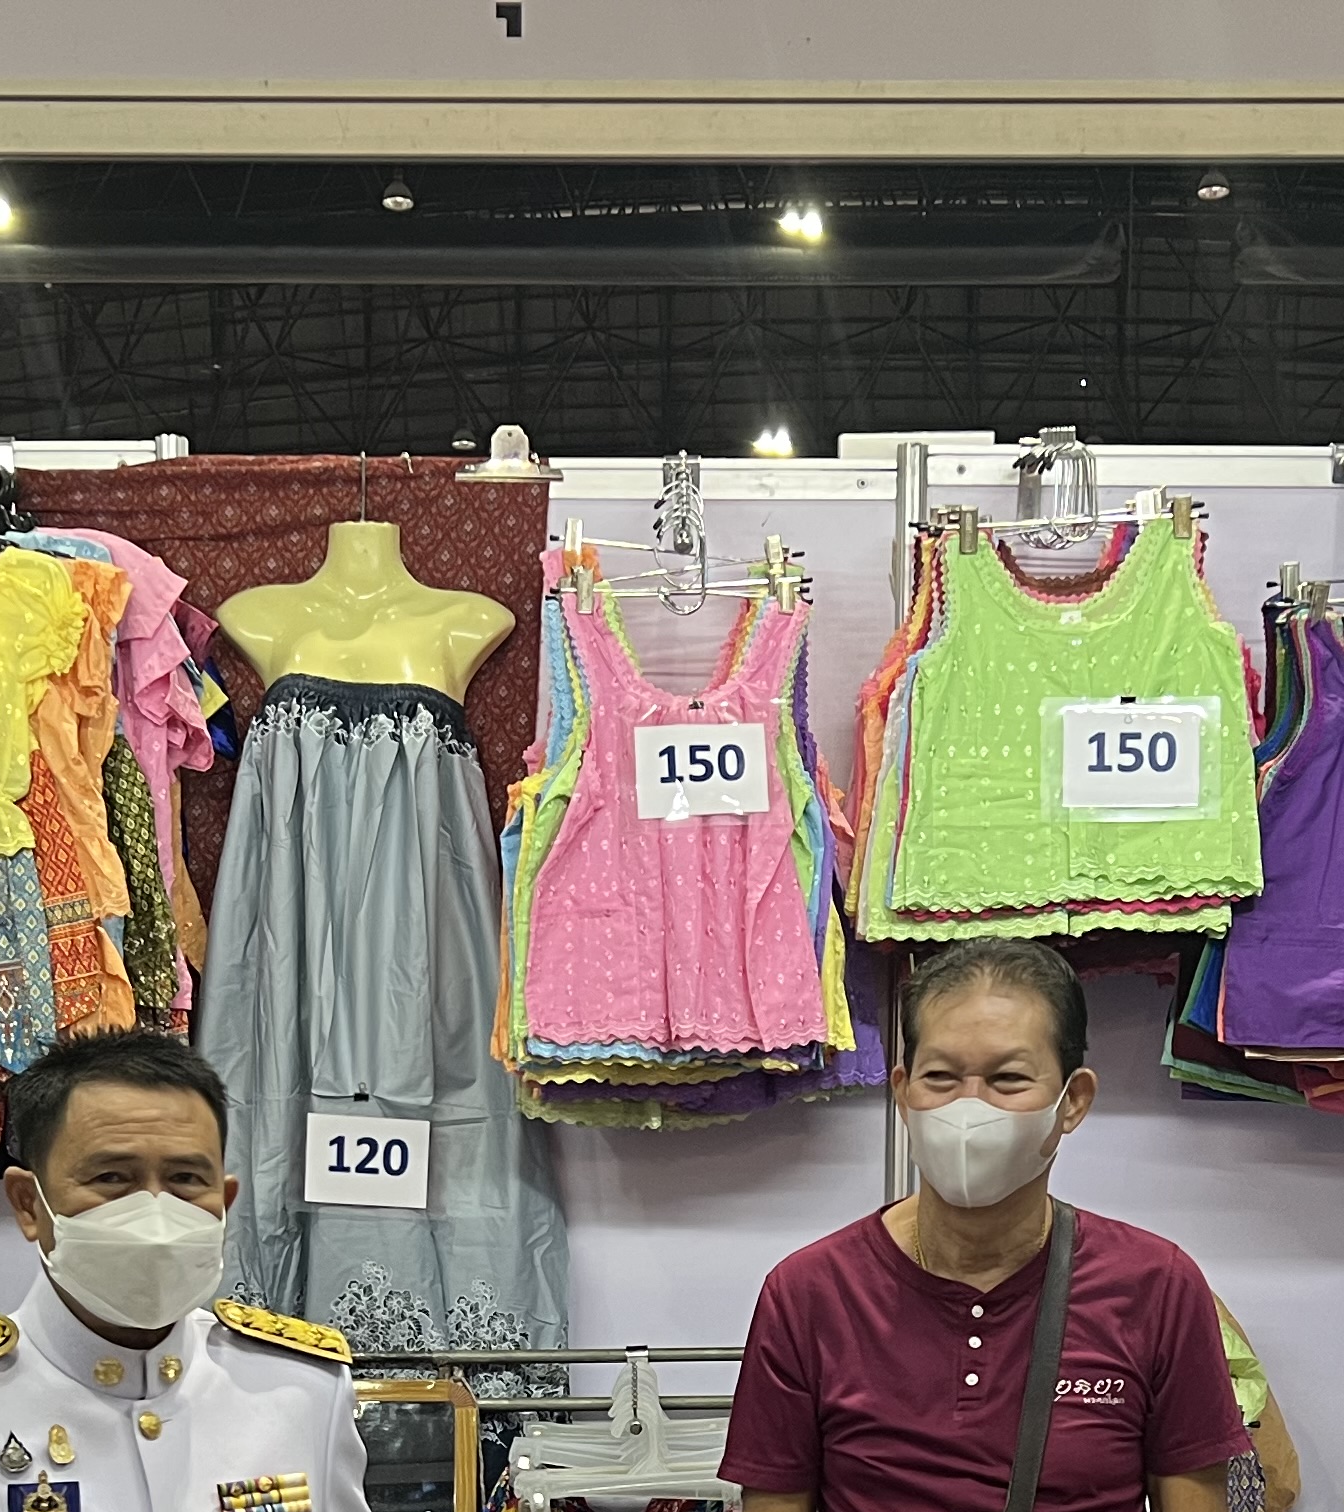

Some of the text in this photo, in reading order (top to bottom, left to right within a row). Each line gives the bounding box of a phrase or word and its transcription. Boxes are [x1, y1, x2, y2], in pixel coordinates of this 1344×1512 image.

[659, 744, 745, 783] 150
[1088, 732, 1176, 772] 150
[328, 1136, 408, 1176] 120
